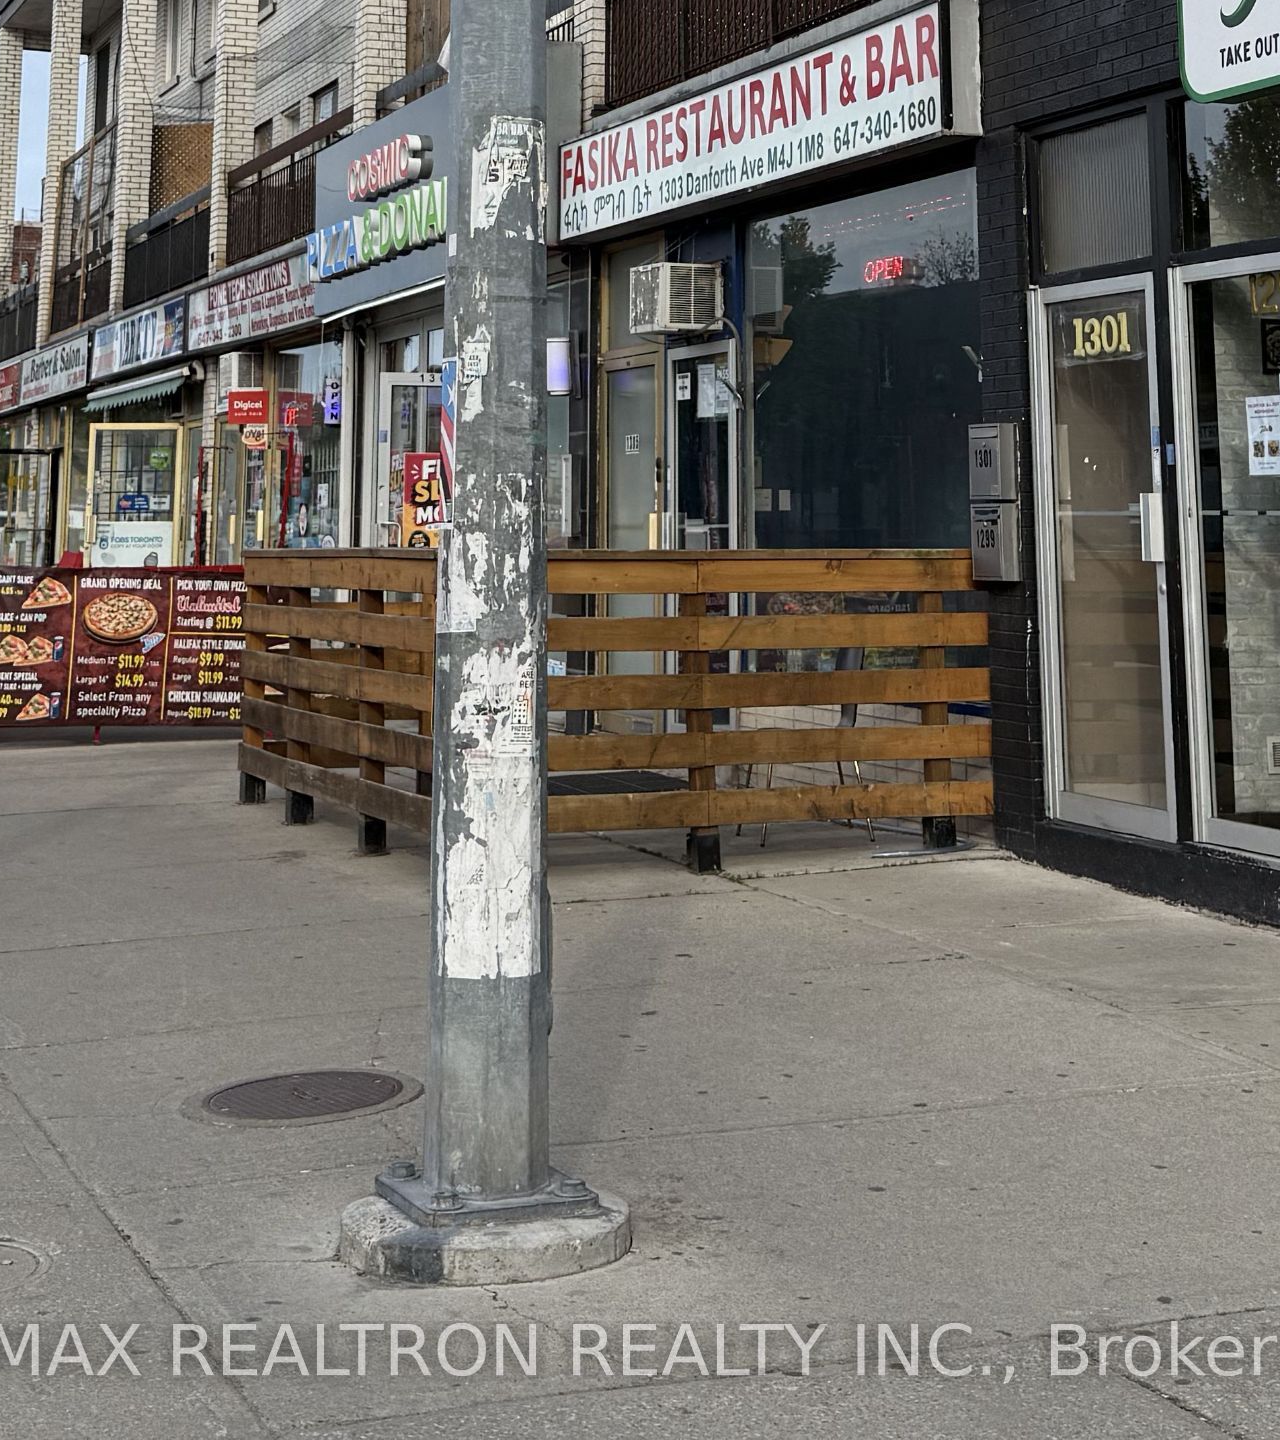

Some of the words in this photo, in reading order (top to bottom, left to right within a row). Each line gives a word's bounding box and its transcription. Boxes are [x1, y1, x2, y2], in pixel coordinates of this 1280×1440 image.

[1220, 39, 1252, 68] TAKE
[1255, 32, 1280, 59] OUT
[562, 127, 639, 199] FASIKA
[646, 51, 834, 173] RESTAURANT
[839, 54, 857, 107] &
[866, 14, 940, 101] BAR
[659, 177, 683, 207] 1303
[686, 160, 737, 195] Danforth
[740, 155, 764, 182] Ave
[767, 144, 794, 174] M4J
[797, 133, 825, 165] 1M8
[833, 95, 937, 155] 647-340-1680
[348, 134, 428, 202] COSMIC
[306, 215, 363, 282] PIZZA
[361, 209, 380, 263] &
[378, 176, 447, 257] DONAI
[864, 256, 904, 283] OPEN
[228, 277, 246, 303] TECH
[247, 260, 288, 298] SOLUTIONS
[1072, 311, 1131, 358] 1301
[30, 358, 52, 383] Barber
[60, 346, 81, 373] Salon
[420, 374, 442, 383] 13
[233, 400, 263, 410] Digicel
[330, 382, 340, 420] OPEN
[975, 448, 992, 468] 1301
[977, 529, 996, 548] 1299
[17, 575, 34, 584] SLICE
[81, 578, 107, 589] GRAND
[109, 578, 141, 589] OPENING
[143, 579, 162, 590] DEAL
[177, 579, 194, 591] PICK
[194, 579, 212, 591] YOUR
[213, 580, 230, 591] OWN
[231, 581, 248, 592] PIZZ
[20, 613, 33, 621] CAN
[34, 613, 47, 622] POP
[177, 616, 204, 629] Starting
[205, 616, 214, 629] @
[216, 614, 242, 630] $11.99
[174, 639, 200, 649] HALIFAX
[201, 639, 222, 649] STYLE
[77, 655, 106, 665] Medium
[118, 653, 145, 668] $11.99
[173, 655, 198, 664] Regular
[200, 651, 224, 667] $9.99
[13, 672, 38, 681] SPECIAL
[76, 675, 97, 685] Large
[115, 673, 144, 688] $14.99
[172, 673, 191, 682] Large
[198, 670, 223, 685] $11.99
[78, 691, 106, 702] Select
[109, 691, 133, 702] From
[135, 694, 152, 704] any
[168, 691, 201, 703] CHICKEN
[202, 692, 244, 703] SHAWARM
[77, 706, 120, 718] speciality
[122, 706, 146, 716] Pizza
[212, 709, 228, 717] Large
